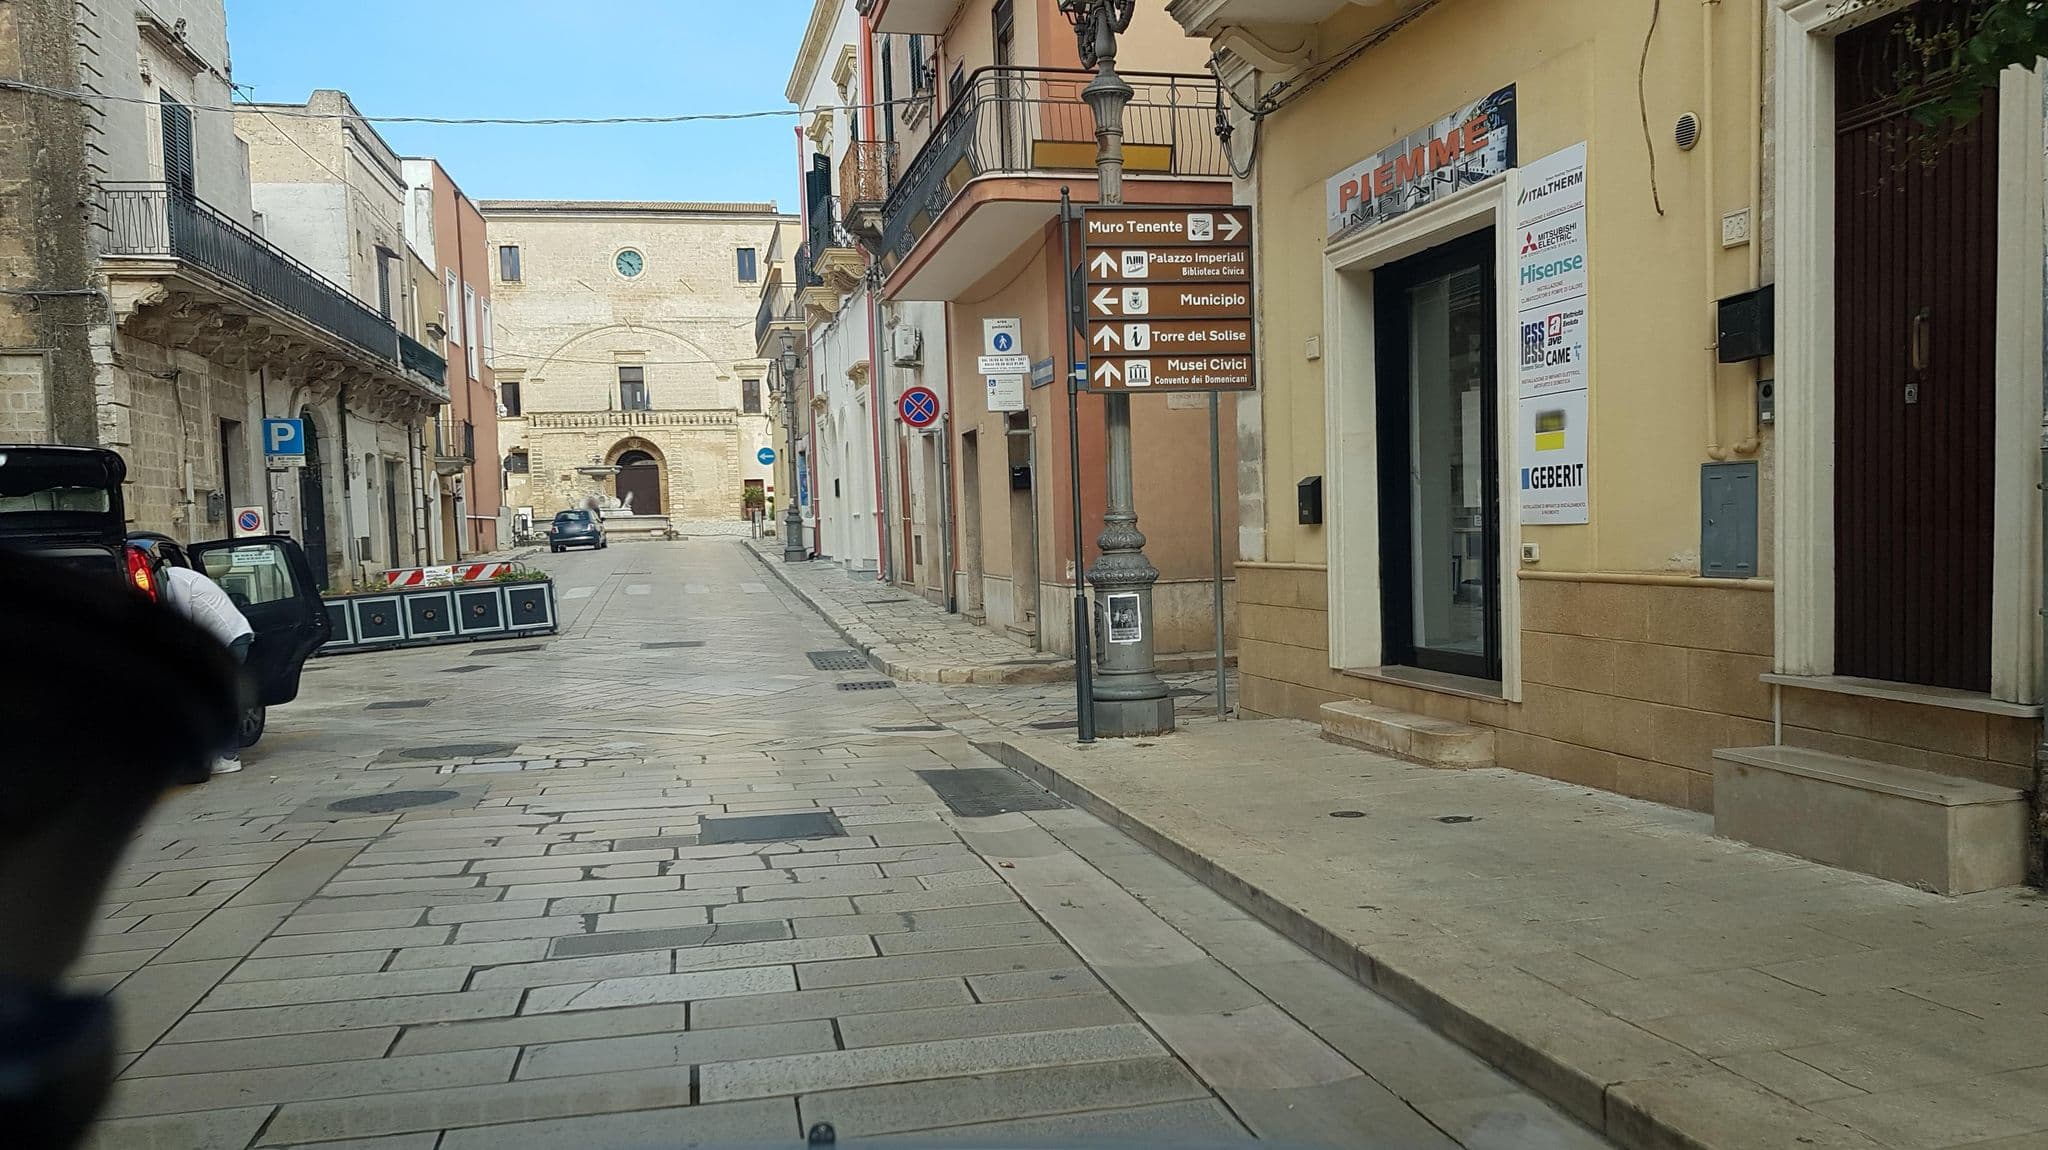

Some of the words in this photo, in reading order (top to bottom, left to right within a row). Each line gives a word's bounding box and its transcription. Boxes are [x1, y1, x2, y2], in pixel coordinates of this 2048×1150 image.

[1339, 113, 1489, 213] PIEMME
[1342, 153, 1486, 229] IMPIANTI
[1529, 171, 1583, 202] ITALTHERM
[1089, 221, 1124, 233] Muro
[1127, 220, 1183, 233] Tenente
[1538, 222, 1577, 241] MITSUBISHI
[1538, 232, 1572, 249] ELECTRIC
[1149, 253, 1192, 263] Palazzo
[1195, 252, 1244, 264] Imperiali
[1182, 267, 1220, 276] Biblioteca
[1222, 267, 1244, 276] Civica
[1520, 254, 1583, 286] Hisense
[1181, 293, 1245, 307] Municipio
[1152, 331, 1184, 342] Torre
[1187, 331, 1206, 342] del
[1209, 330, 1246, 341] Solise
[1547, 336, 1562, 346] ave
[1168, 359, 1207, 371] Musei
[1210, 358, 1247, 370] Civici
[1546, 347, 1571, 366] CAME
[1154, 375, 1189, 384] Convento
[1191, 375, 1203, 384] dei
[1205, 374, 1247, 384] Domenicani
[270, 422, 296, 451] P
[1531, 464, 1583, 489] GEBERIT
